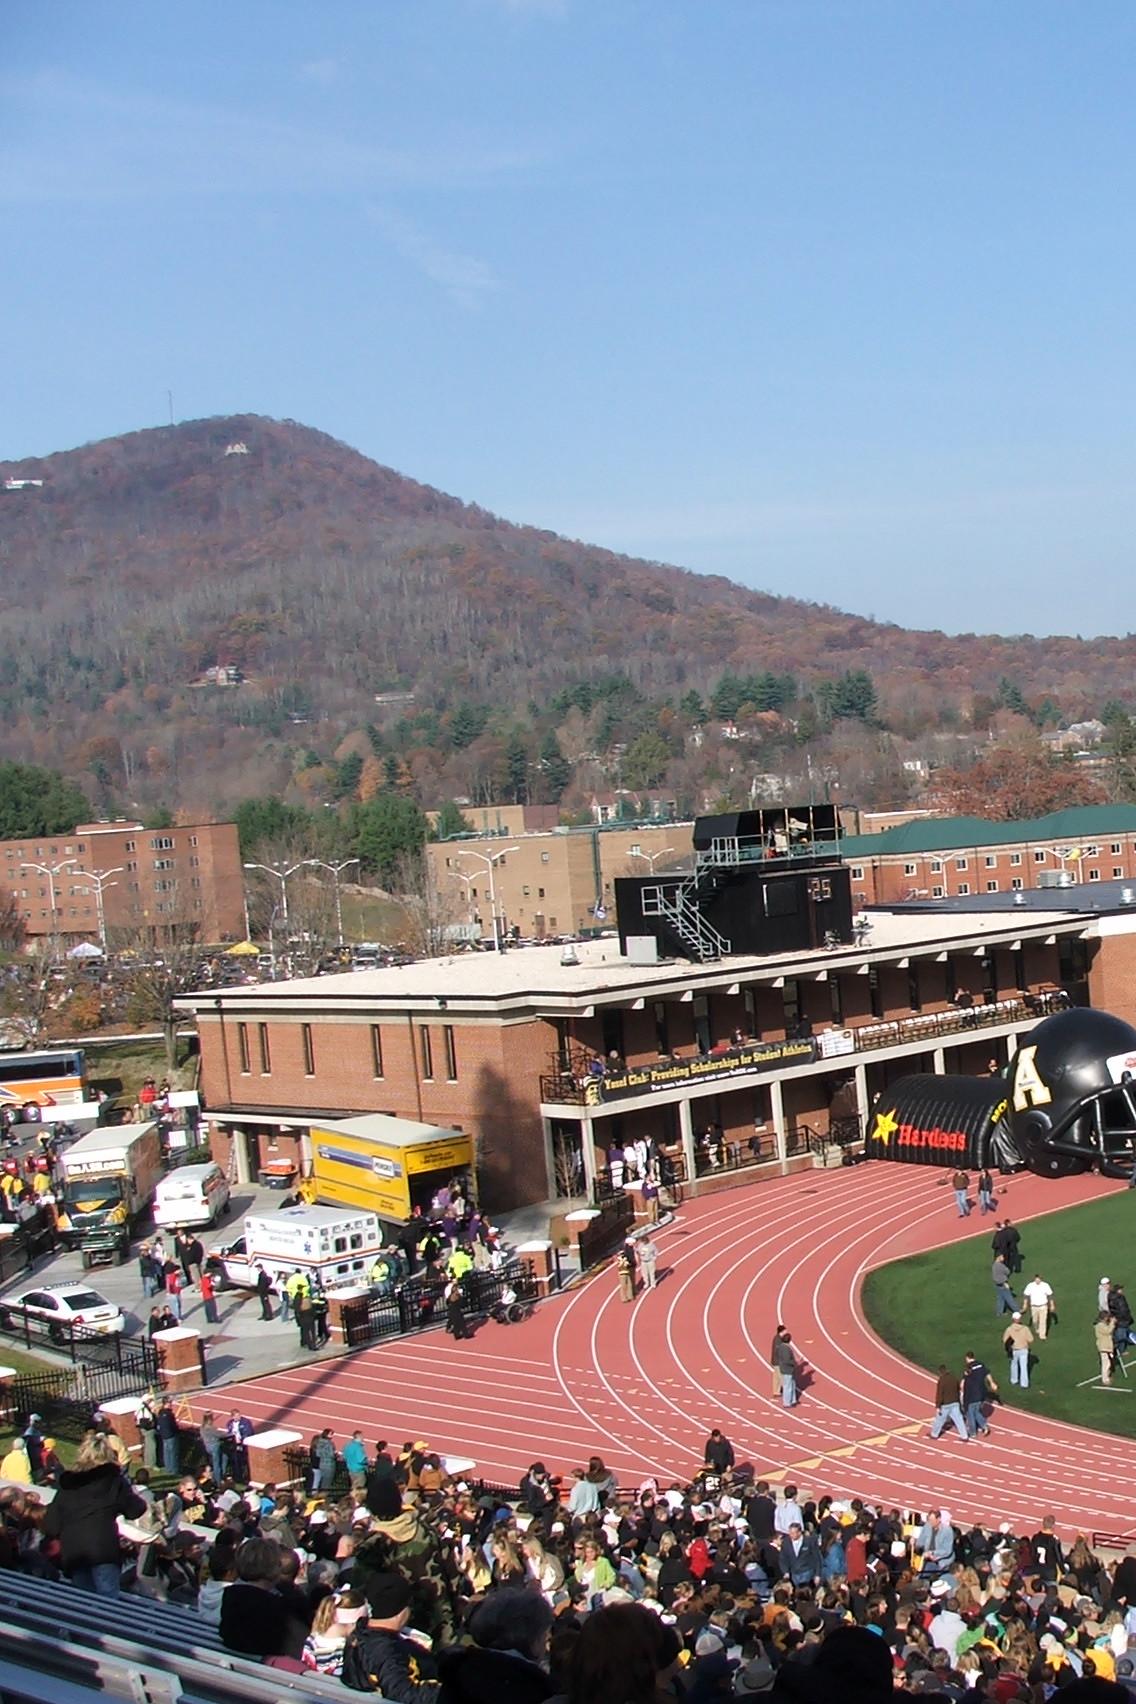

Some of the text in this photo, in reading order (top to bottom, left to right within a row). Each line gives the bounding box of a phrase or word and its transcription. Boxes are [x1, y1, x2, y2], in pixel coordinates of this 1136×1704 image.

[651, 1066, 690, 1082] Providing
[691, 1056, 739, 1074] Scholarships
[740, 1054, 752, 1065] for
[753, 1049, 781, 1062] Student
[782, 1043, 812, 1057] Athletes
[1012, 1045, 1053, 1113] A
[1037, 1546, 1046, 1564] 7
